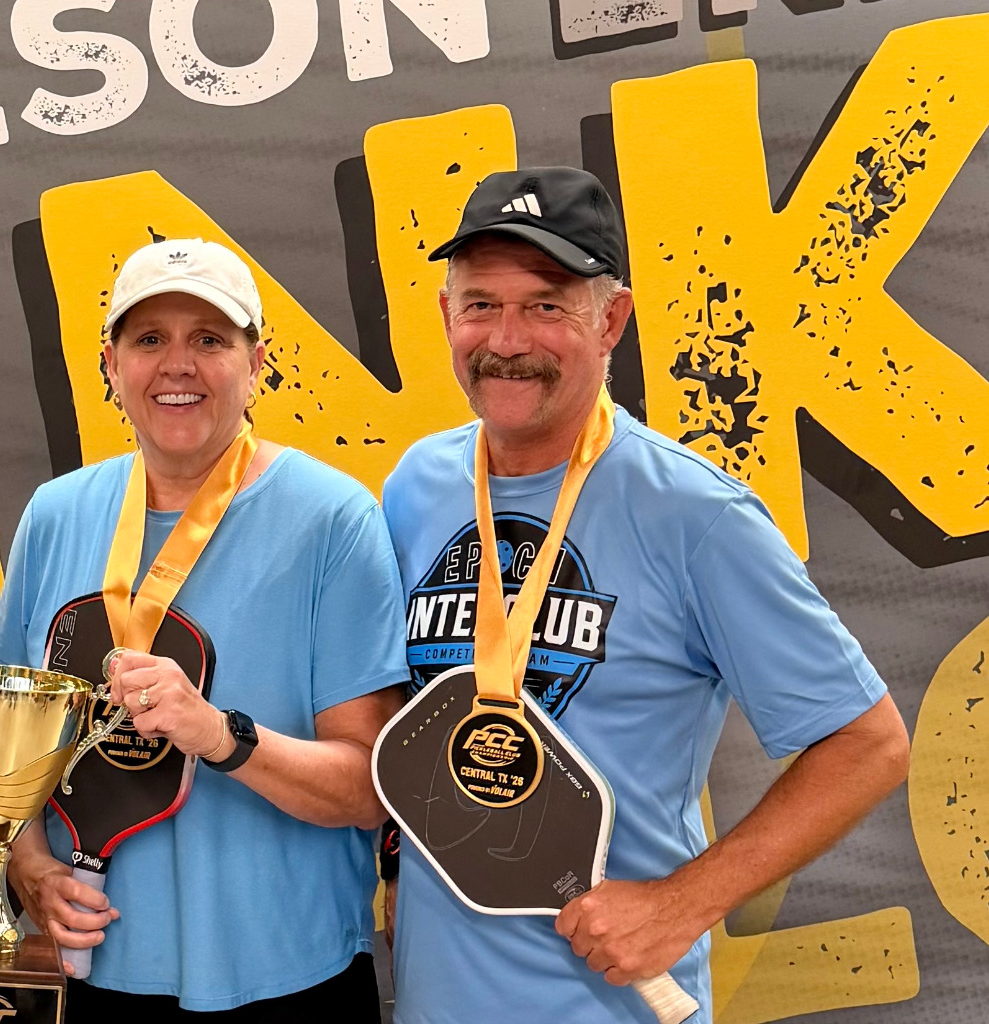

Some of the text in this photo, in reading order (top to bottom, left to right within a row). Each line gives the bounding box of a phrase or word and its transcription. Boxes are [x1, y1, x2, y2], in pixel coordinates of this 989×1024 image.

[402, 696, 456, 746] GEARBOX
[106, 733, 133, 746] ENTRAL
[462, 729, 525, 752] PCC
[460, 766, 496, 782] CENTRAL
[497, 772, 509, 784] TX
[82, 854, 104, 870] Shelly
